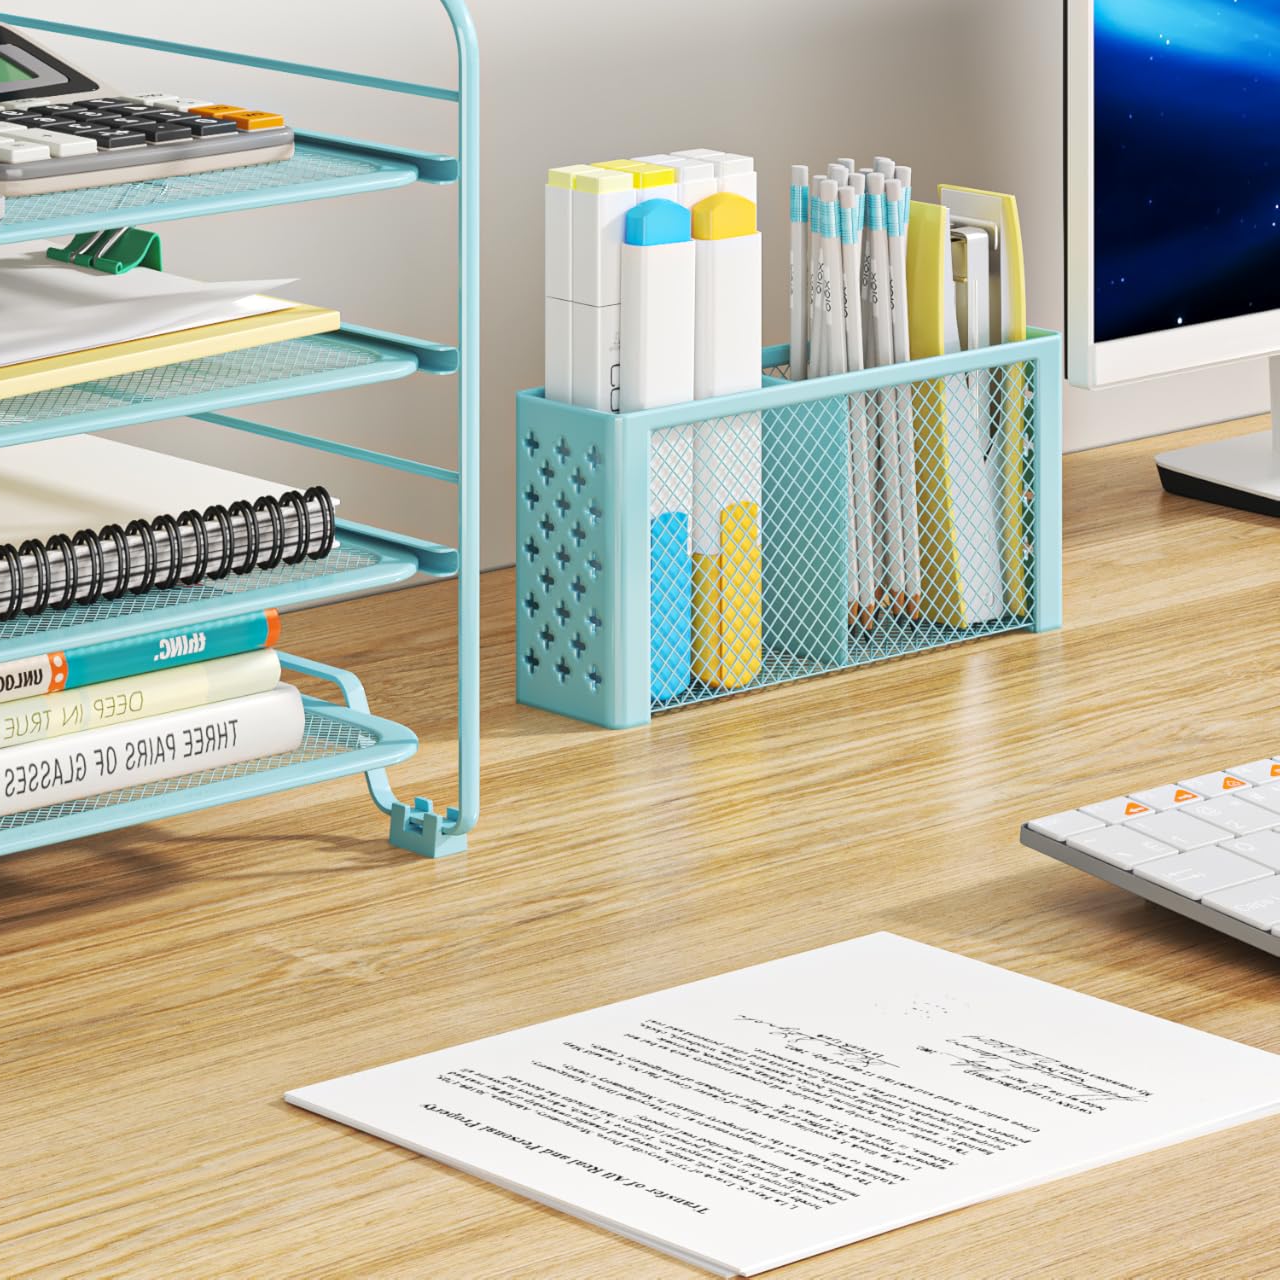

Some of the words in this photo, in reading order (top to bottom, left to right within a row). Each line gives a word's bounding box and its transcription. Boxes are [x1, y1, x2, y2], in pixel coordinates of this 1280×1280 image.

[421, 1103, 482, 1129] Property
[476, 1124, 544, 1152] Personal
[537, 1147, 572, 1161] and
[565, 1158, 605, 1175] Real
[600, 1171, 631, 1183] All
[621, 1180, 647, 1189] of
[644, 1187, 710, 1215] Transfer
